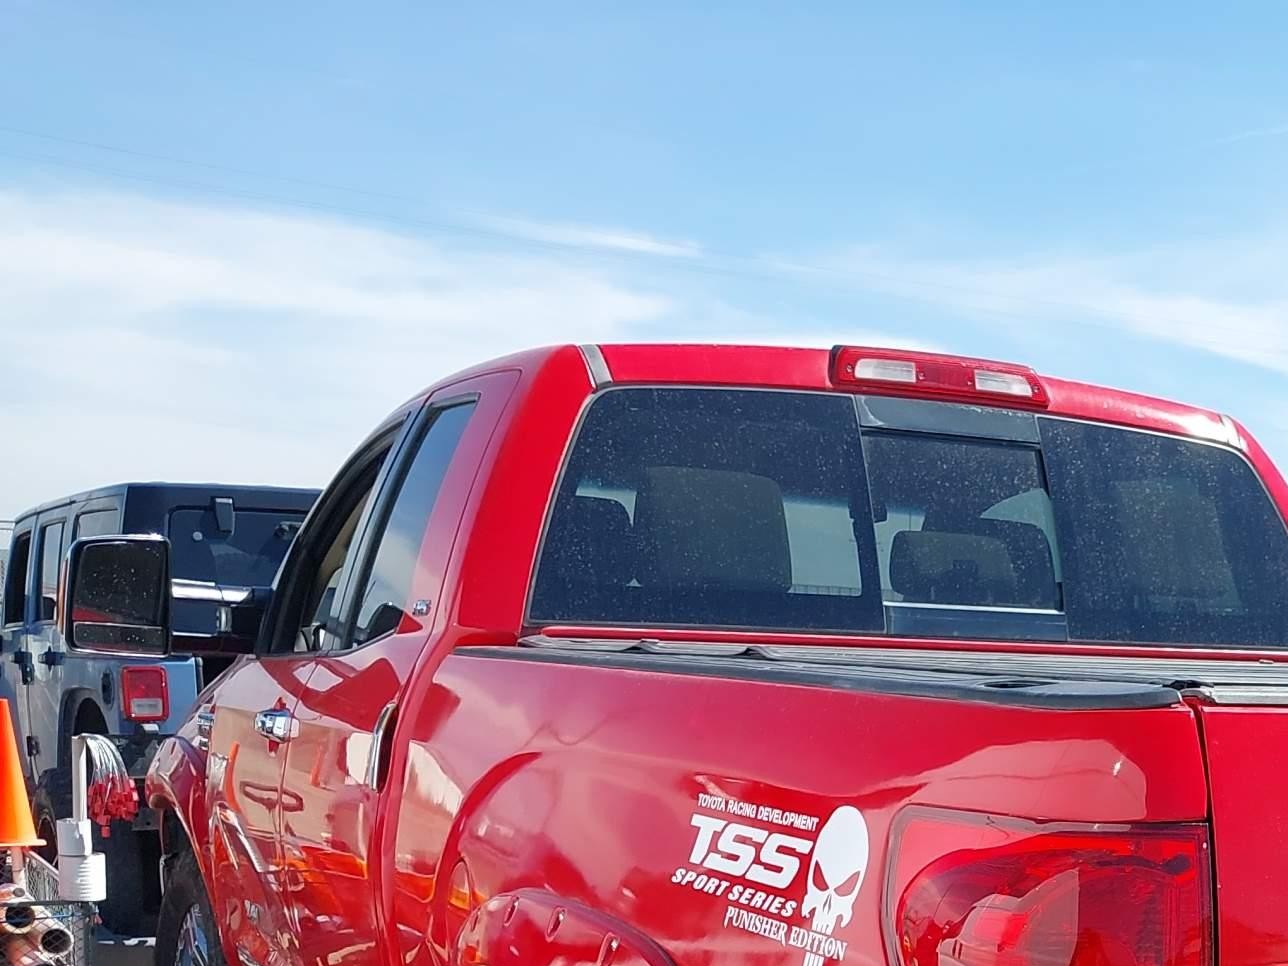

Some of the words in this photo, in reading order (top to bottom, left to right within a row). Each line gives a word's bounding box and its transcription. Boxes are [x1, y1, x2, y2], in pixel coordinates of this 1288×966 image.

[698, 793, 726, 812] TOYOTA
[727, 799, 757, 817] RACING
[758, 807, 819, 832] DEVELOPMENT
[688, 813, 813, 889] TSS
[671, 868, 730, 896] SPORT
[727, 885, 797, 918] SERIES
[724, 906, 788, 947] PUNISHER
[788, 925, 848, 961] EDITION
